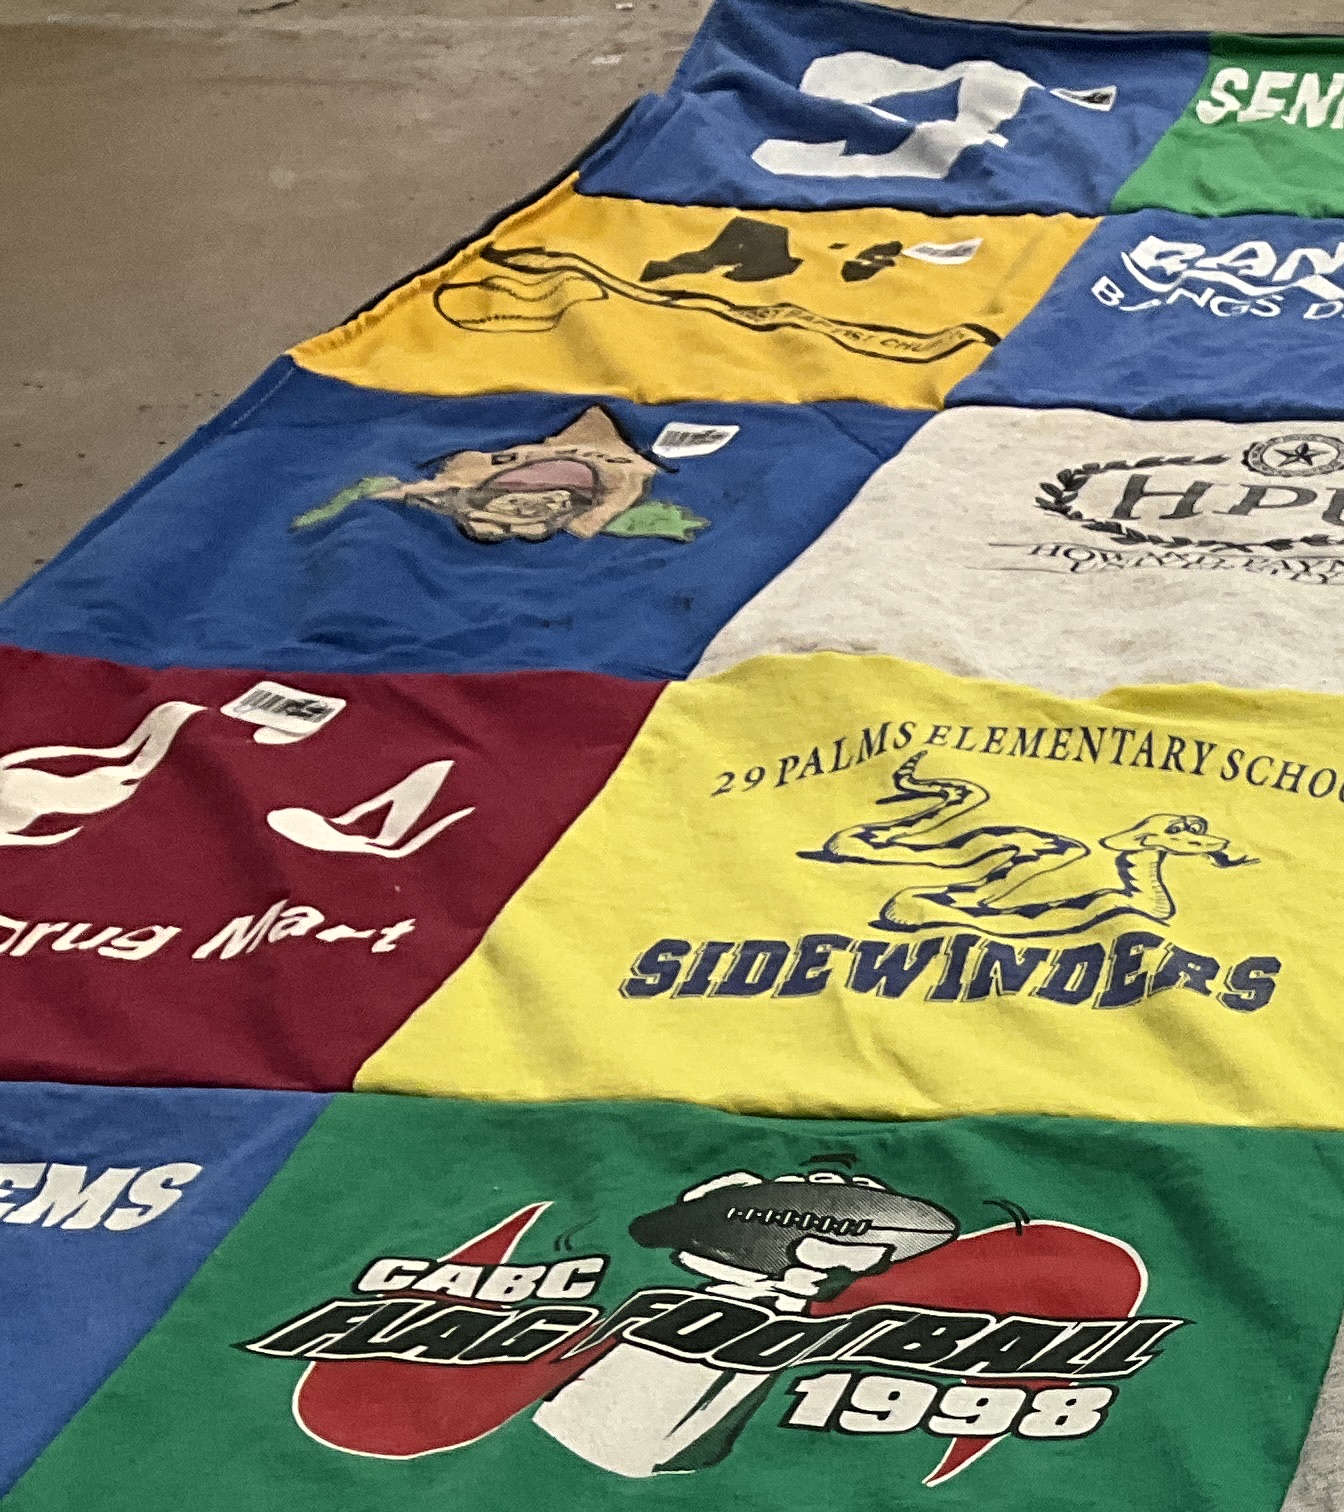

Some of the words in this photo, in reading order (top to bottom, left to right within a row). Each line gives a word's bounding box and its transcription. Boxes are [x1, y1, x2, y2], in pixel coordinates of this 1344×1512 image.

[711, 764, 766, 797] 29
[774, 720, 918, 788] PALMS
[925, 723, 1220, 777] ELEMENTARY
[192, 899, 416, 960] Mart
[618, 932, 1283, 1012] SIDEWINDERS
[236, 1298, 604, 1365] FLAG
[586, 1289, 1196, 1379] FOOTBALL
[780, 1371, 1114, 1442] 1998
